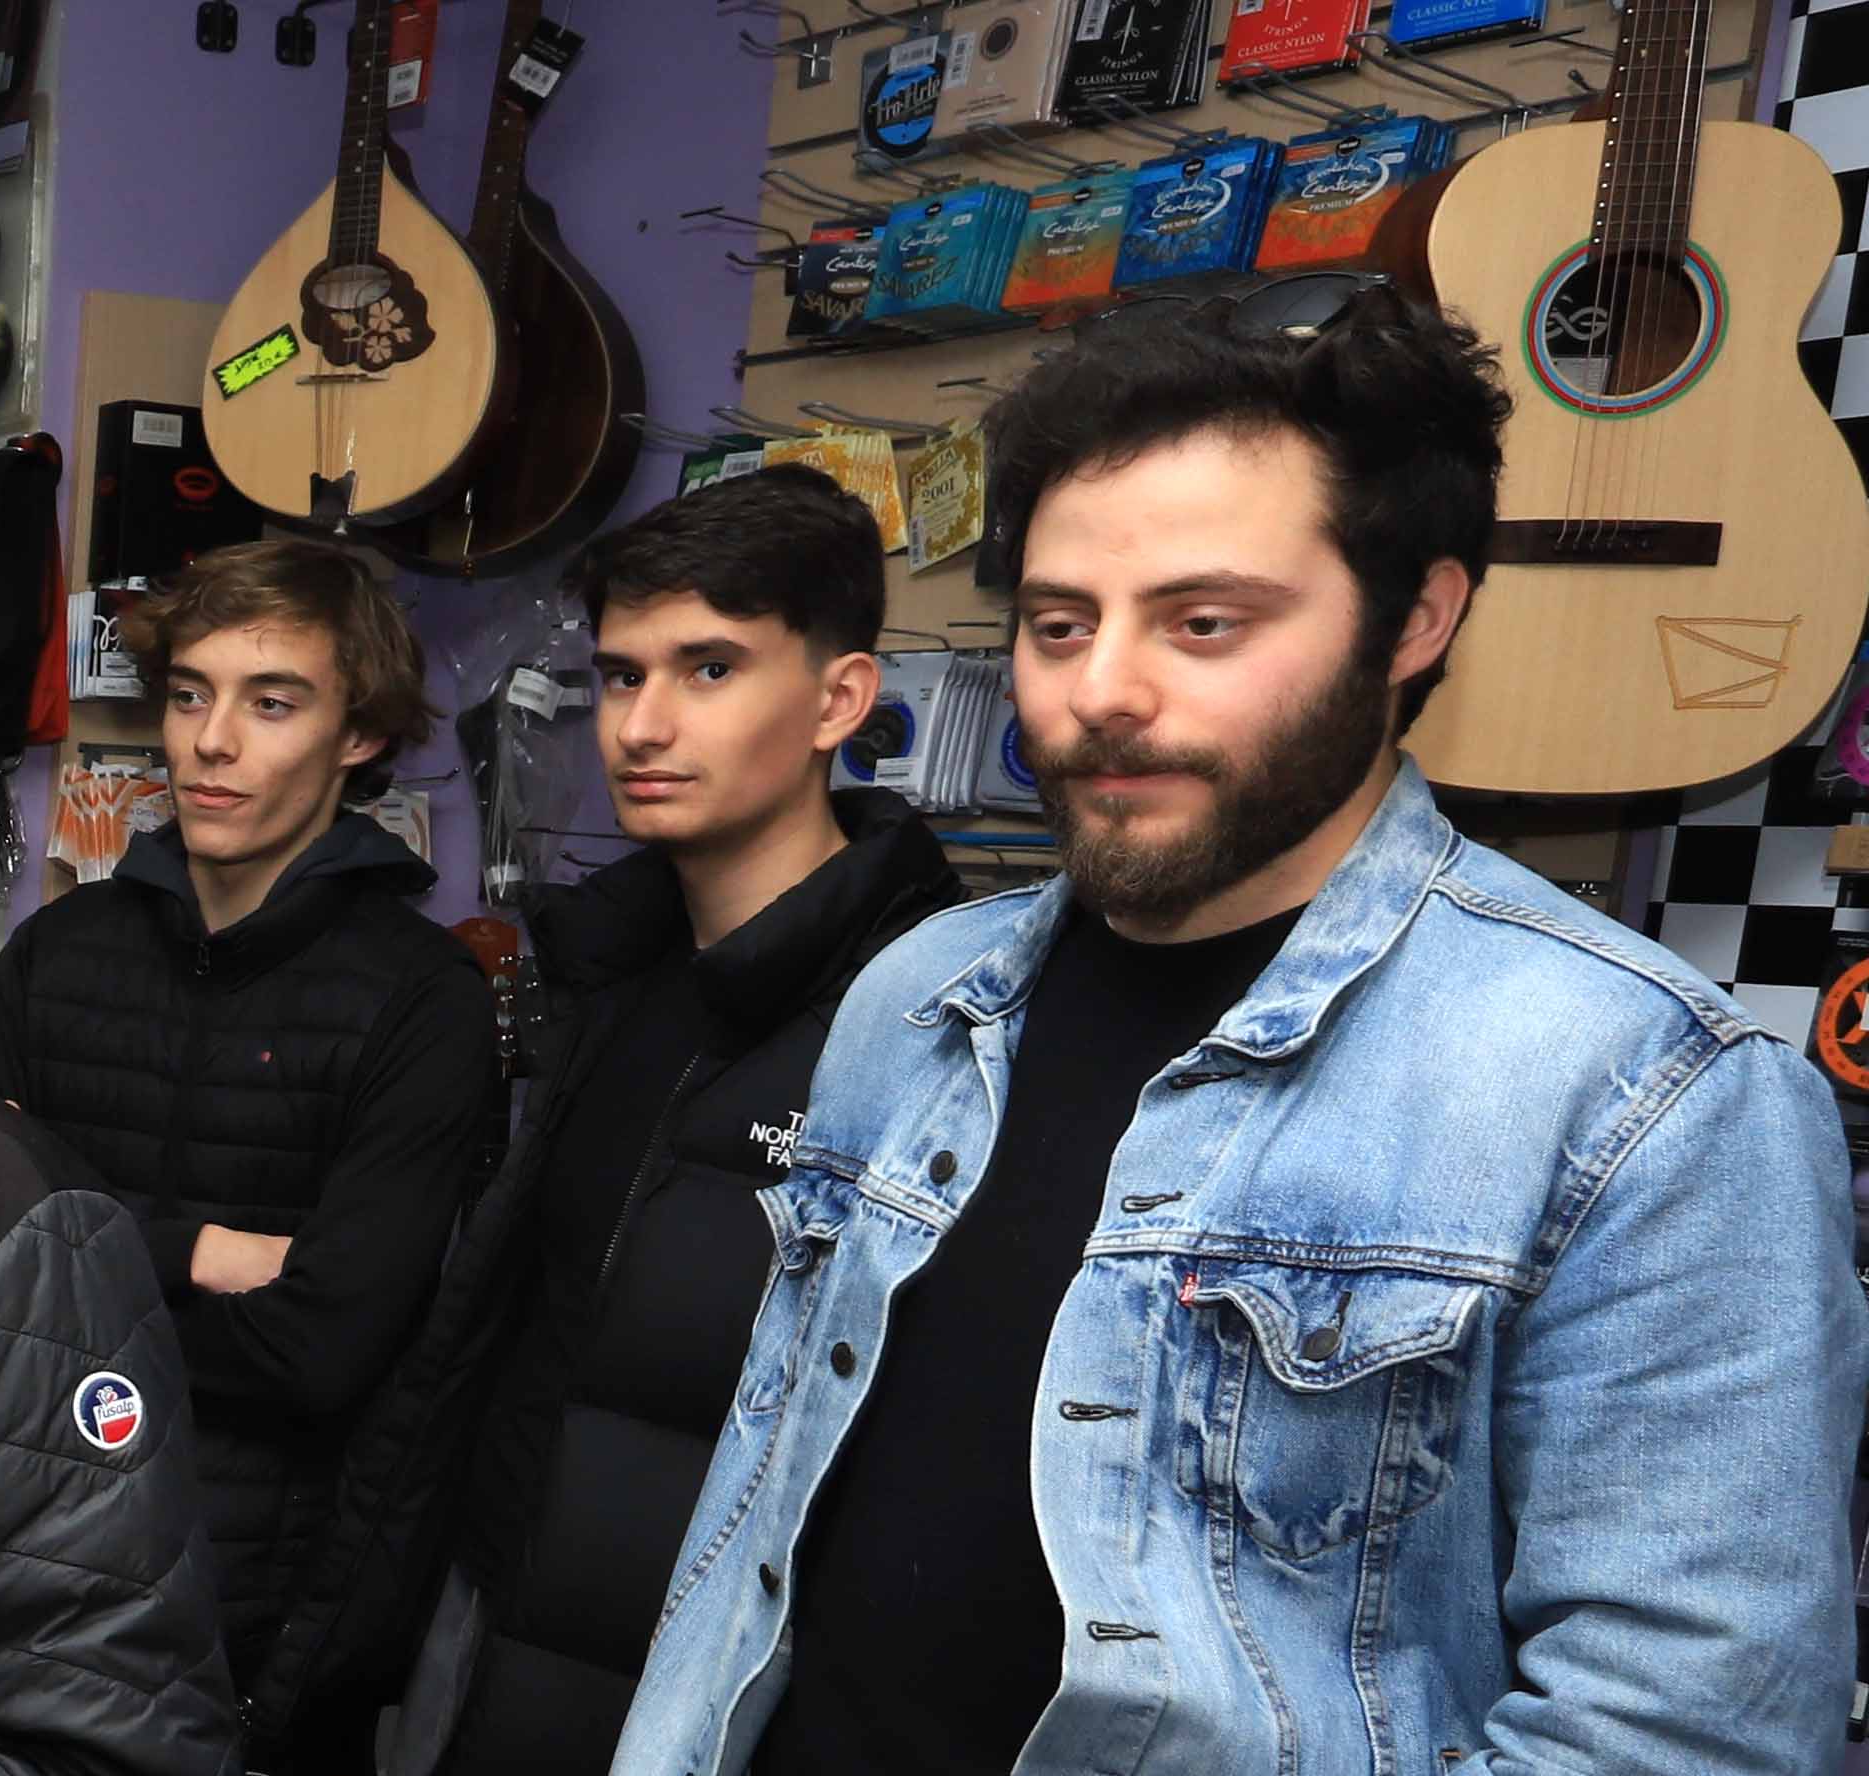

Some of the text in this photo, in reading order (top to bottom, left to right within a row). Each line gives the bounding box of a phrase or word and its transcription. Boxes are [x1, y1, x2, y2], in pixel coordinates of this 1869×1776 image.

[1237, 33, 1326, 58] CLASSIC NYLON
[1074, 70, 1160, 86] CLASSIC NYLON
[921, 479, 956, 506] 2001
[749, 1121, 796, 1149] NOR
[767, 1145, 792, 1168] FA
[97, 1400, 135, 1420] fusalp
